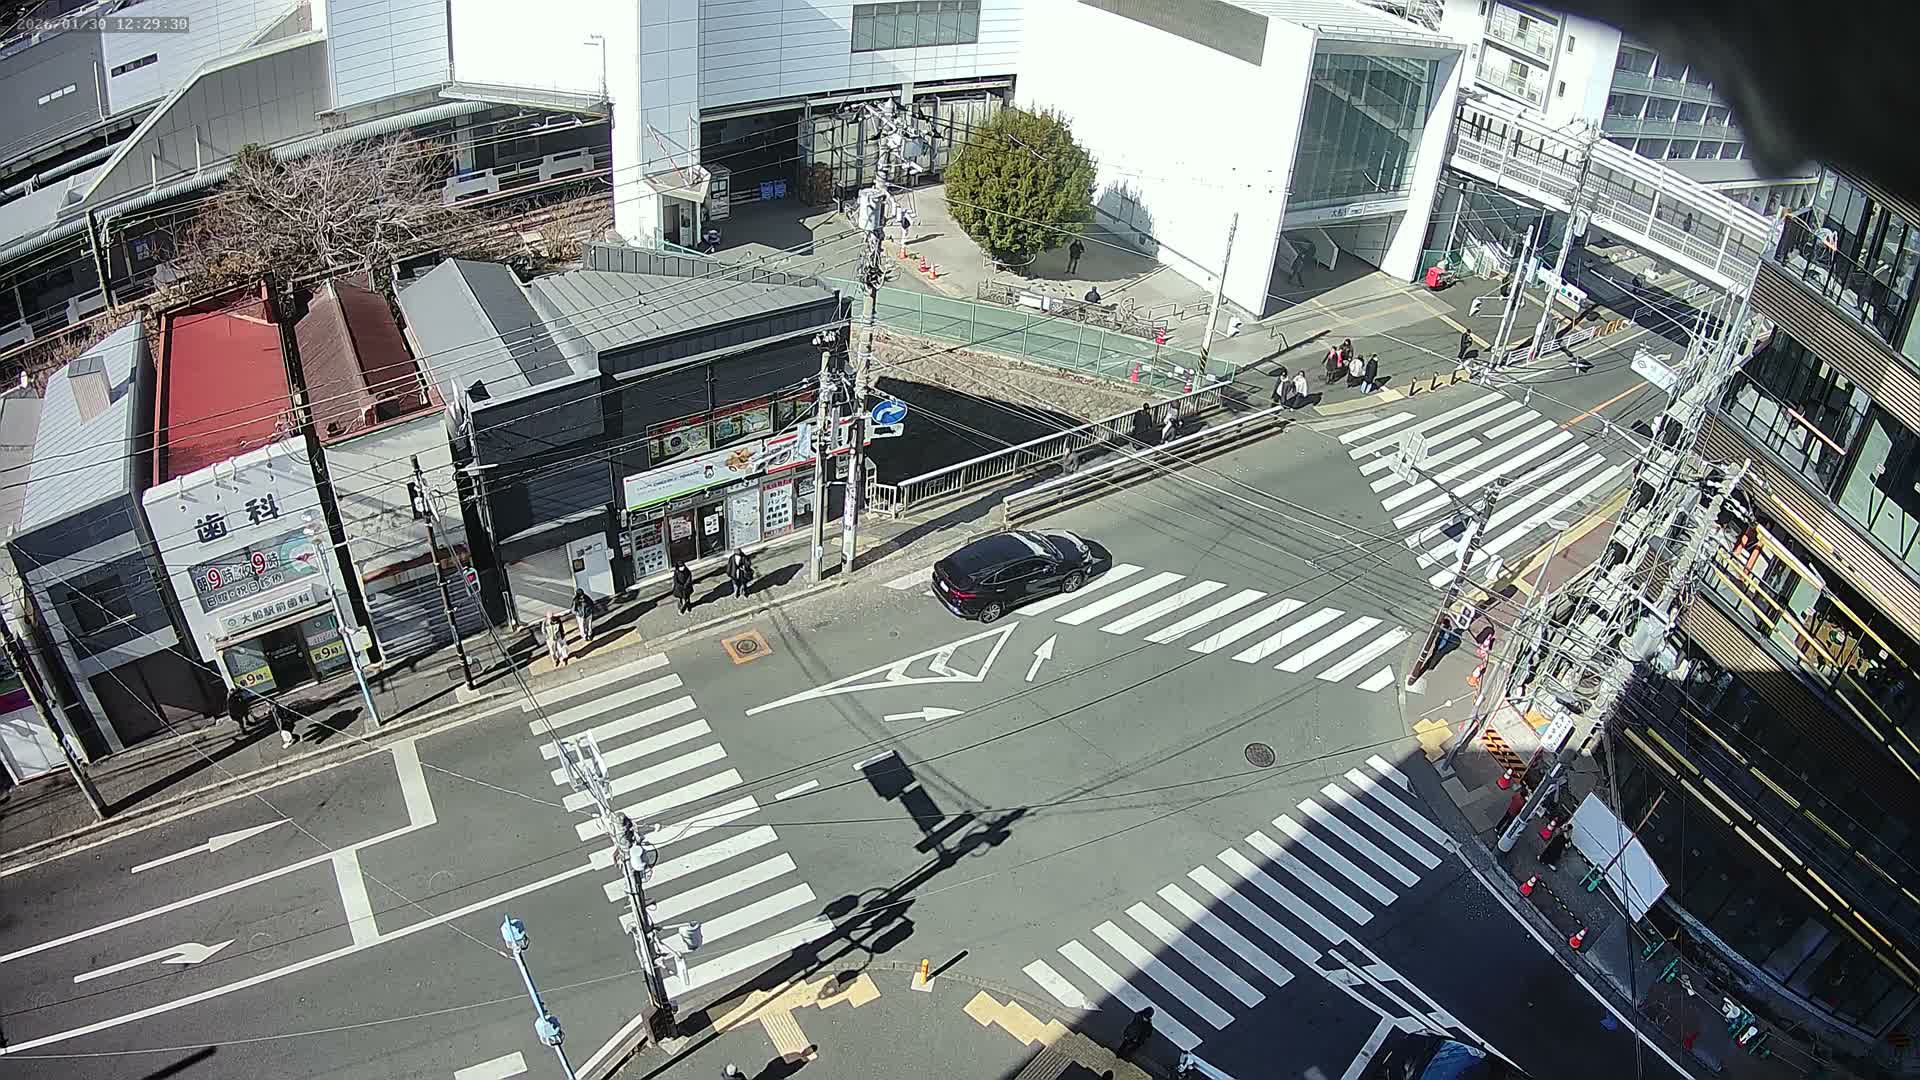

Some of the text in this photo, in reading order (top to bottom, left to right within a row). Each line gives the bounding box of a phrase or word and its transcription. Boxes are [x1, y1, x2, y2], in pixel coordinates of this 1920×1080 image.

[194, 493, 279, 544] 歯科
[241, 592, 310, 625] 大船駅前歯科
